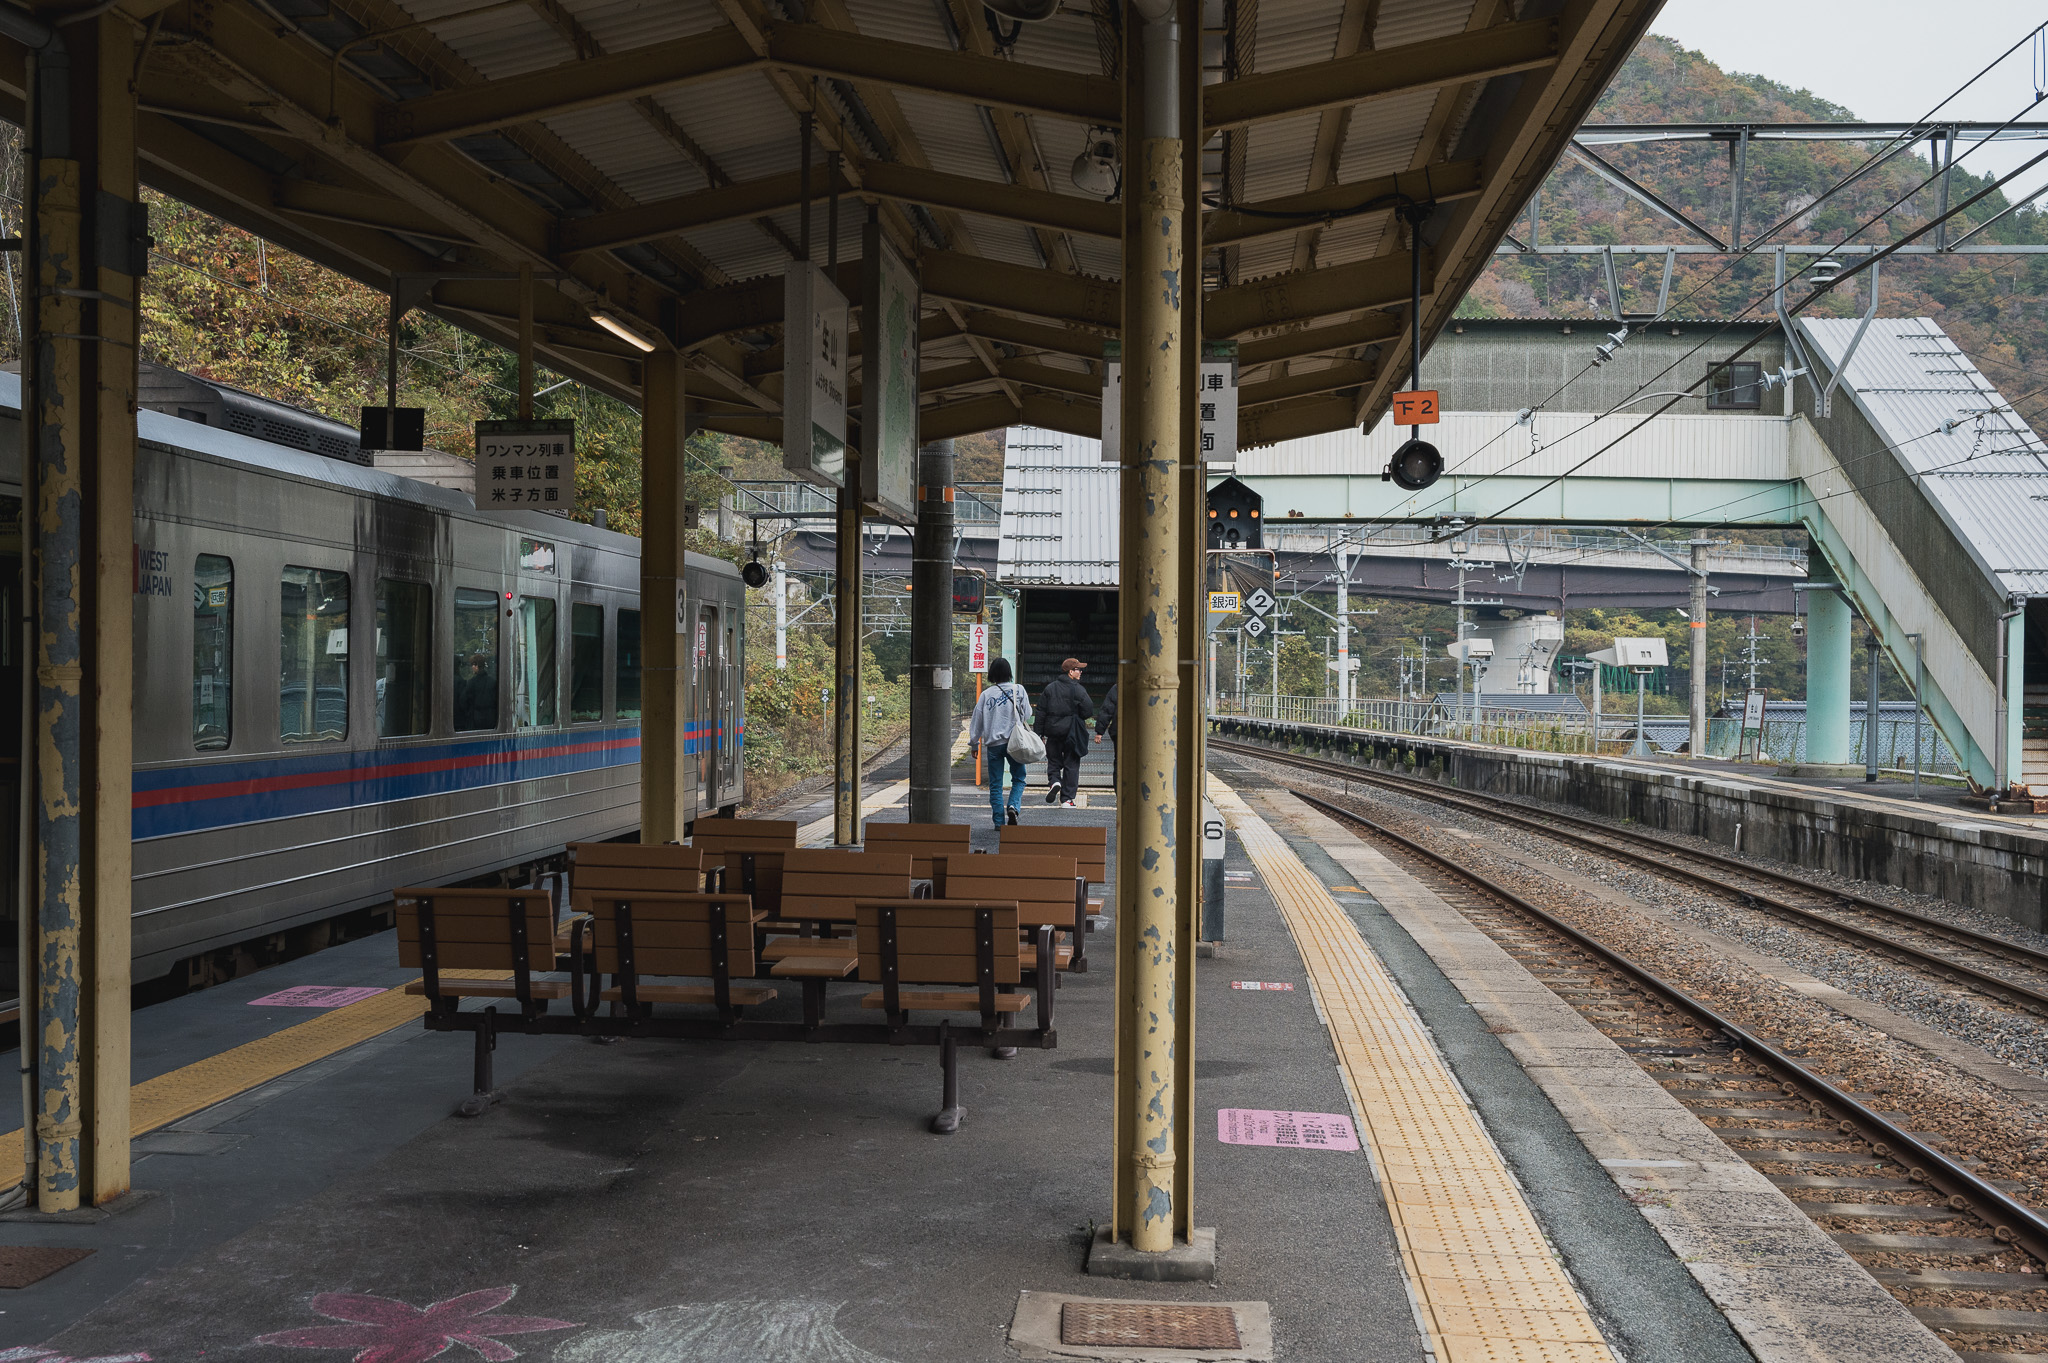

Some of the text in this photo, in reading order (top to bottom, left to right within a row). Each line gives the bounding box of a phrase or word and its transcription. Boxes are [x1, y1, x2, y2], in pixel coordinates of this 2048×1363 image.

[822, 319, 838, 370] 生山
[486, 443, 564, 457] ワンマン列車
[492, 465, 559, 480] 乗車位置
[491, 487, 559, 502] 米子方面
[139, 549, 169, 572] WEST
[139, 574, 172, 597] JAPAN
[677, 588, 685, 624] 3
[1212, 595, 1237, 609] 銀河
[1254, 594, 1268, 608] 2
[1250, 621, 1260, 632] 6
[973, 626, 985, 669] ATS確認
[1203, 820, 1224, 840] 6
